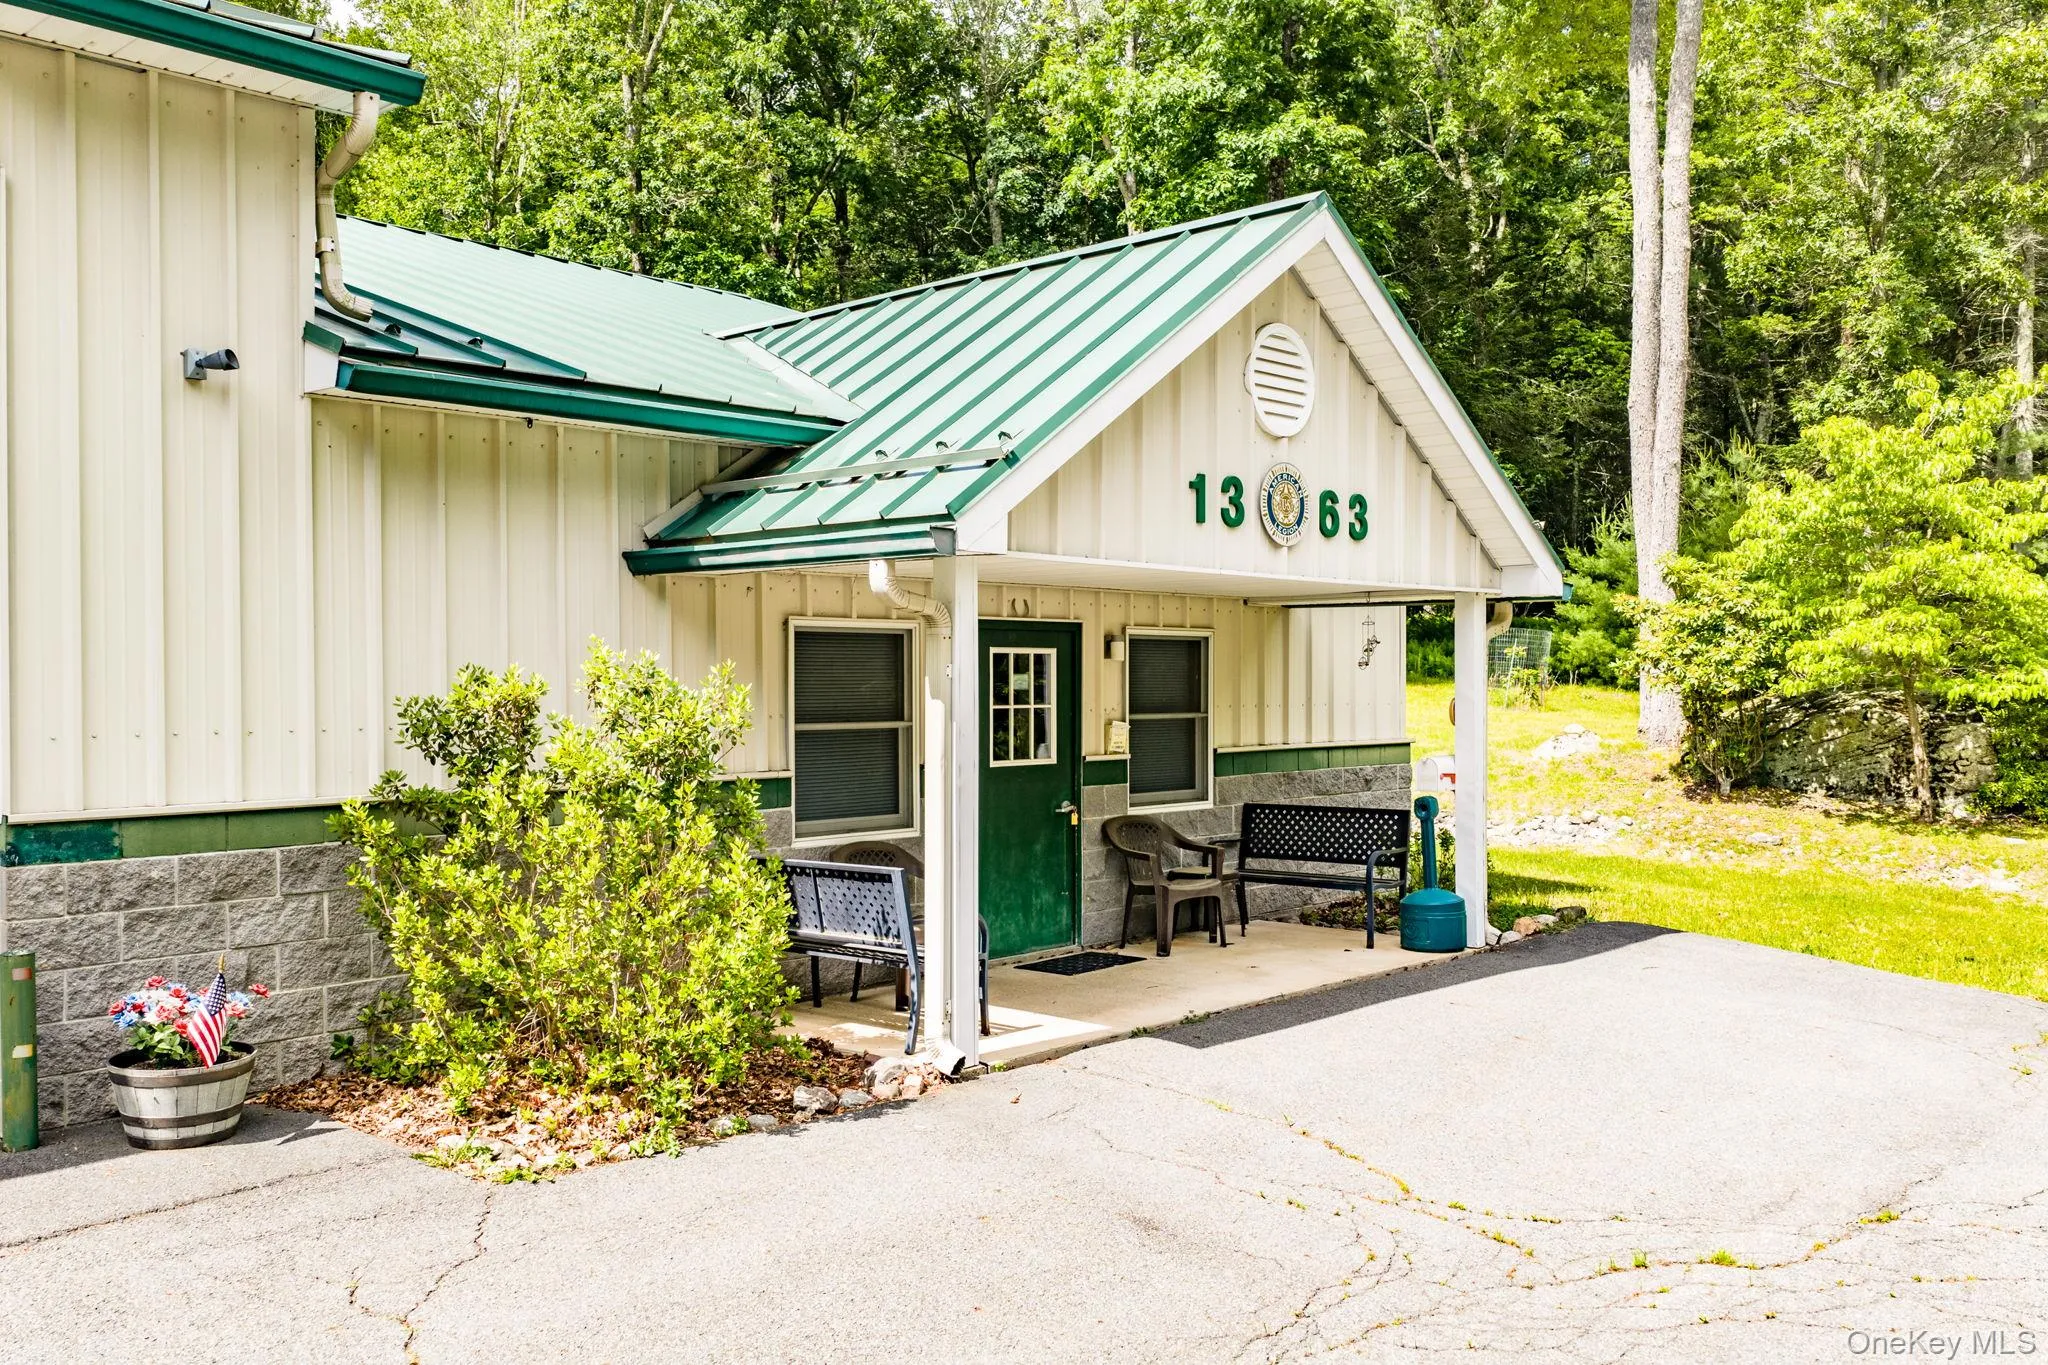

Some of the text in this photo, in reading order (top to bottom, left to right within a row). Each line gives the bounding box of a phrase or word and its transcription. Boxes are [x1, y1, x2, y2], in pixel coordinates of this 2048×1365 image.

[1269, 473, 1304, 498] AMERICAN
[1188, 473, 1369, 541] 13 63
[1274, 522, 1298, 536] LEGION
